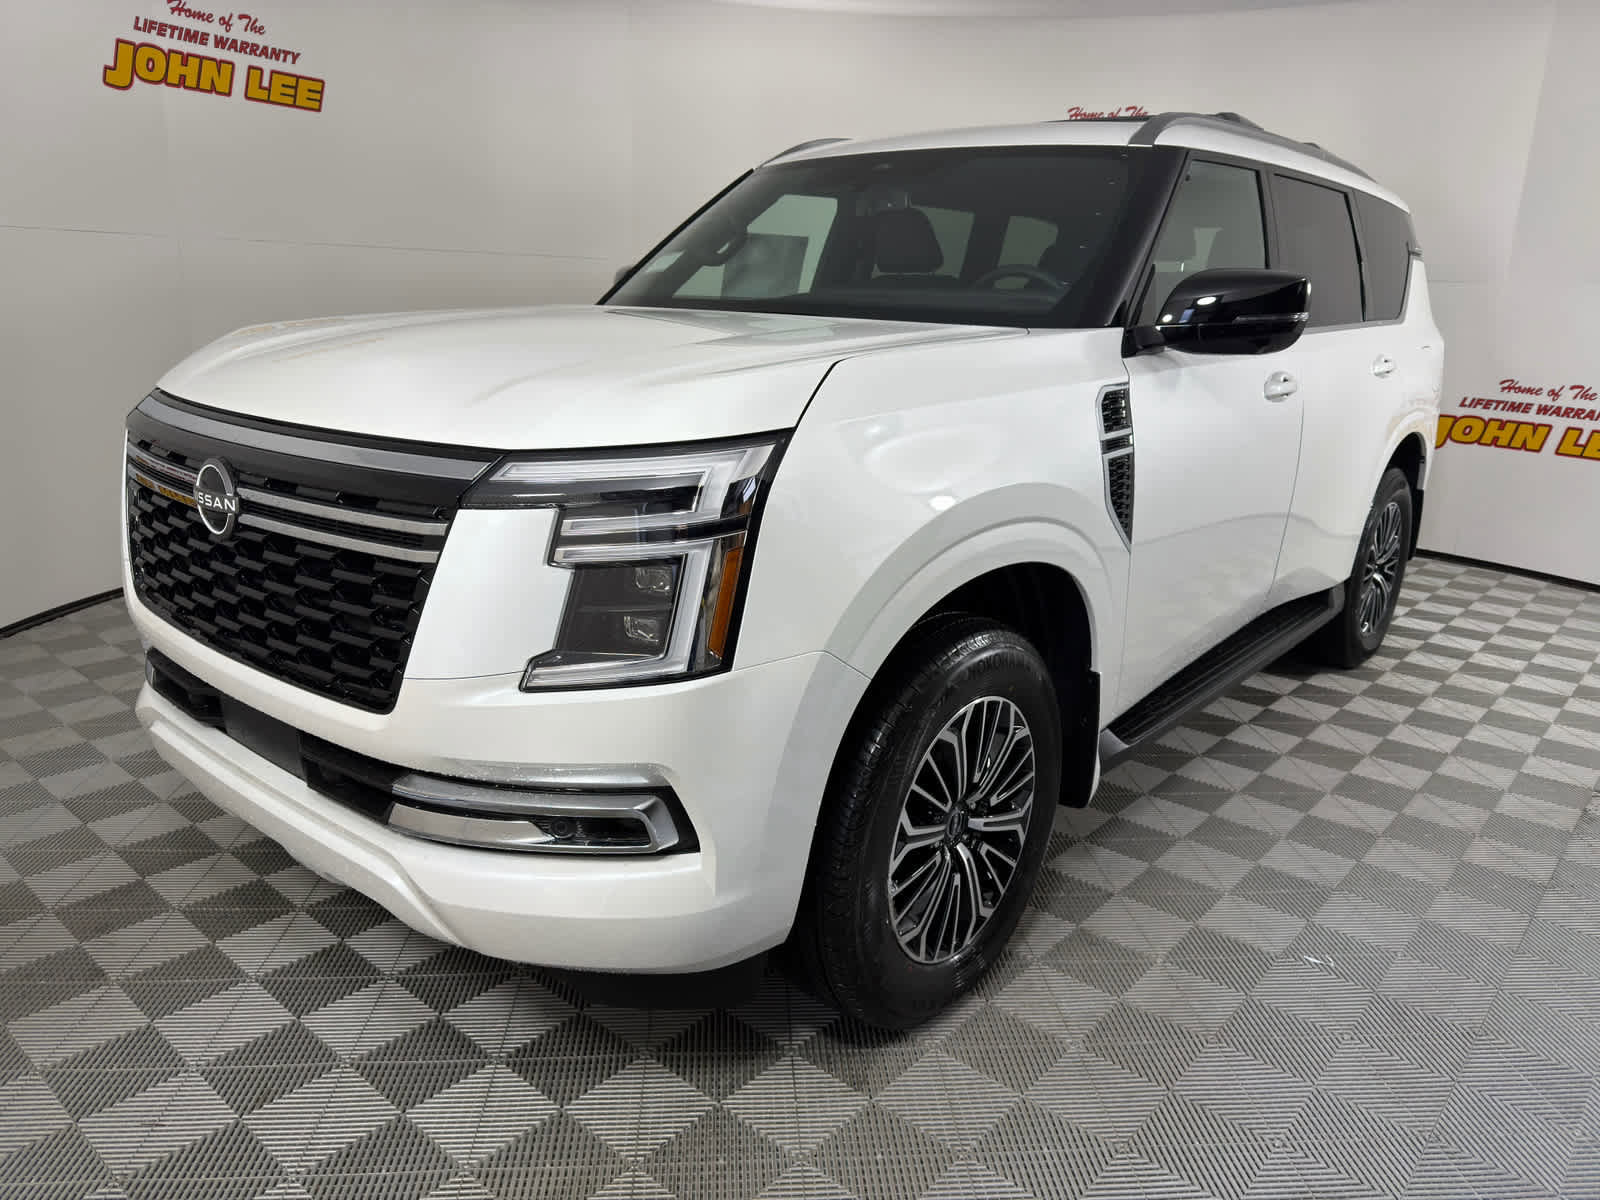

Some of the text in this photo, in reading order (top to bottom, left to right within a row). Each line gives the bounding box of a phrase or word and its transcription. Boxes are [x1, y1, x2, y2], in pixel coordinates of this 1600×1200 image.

[167, 0, 266, 35] Home of The
[133, 16, 302, 65] LIFETIME WARRANTY
[103, 38, 325, 112] JOHN LEE
[1459, 397, 1534, 414] LIFETIME
[1499, 379, 1598, 402] Home of The
